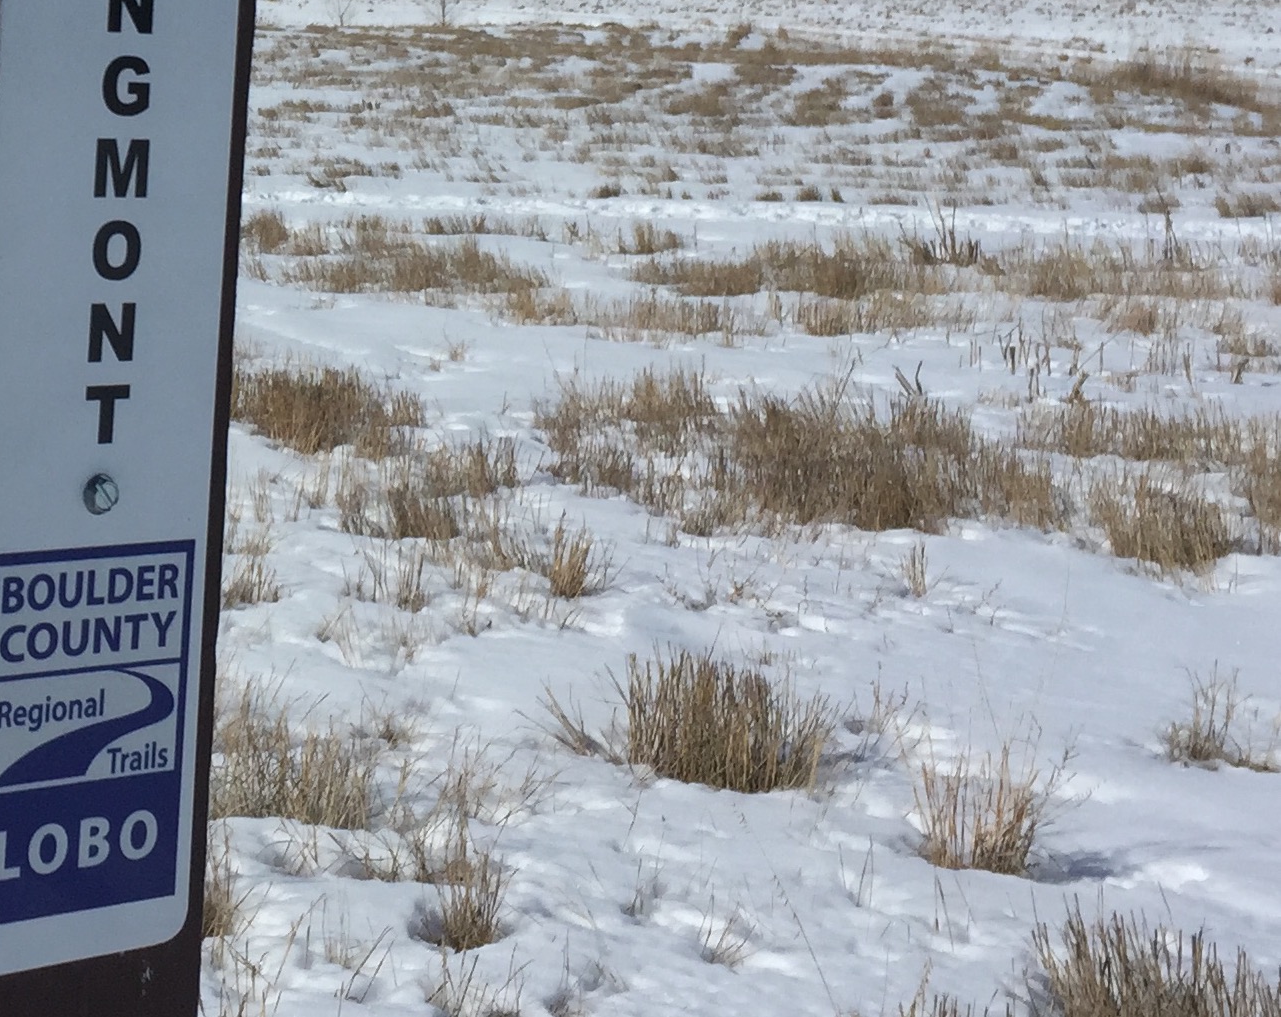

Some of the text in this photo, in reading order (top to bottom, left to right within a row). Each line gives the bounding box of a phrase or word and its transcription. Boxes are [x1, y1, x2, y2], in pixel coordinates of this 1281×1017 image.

[0, 563, 179, 615] BOULDER
[0, 610, 178, 663] COUNTY
[106, 741, 169, 775] Trails
